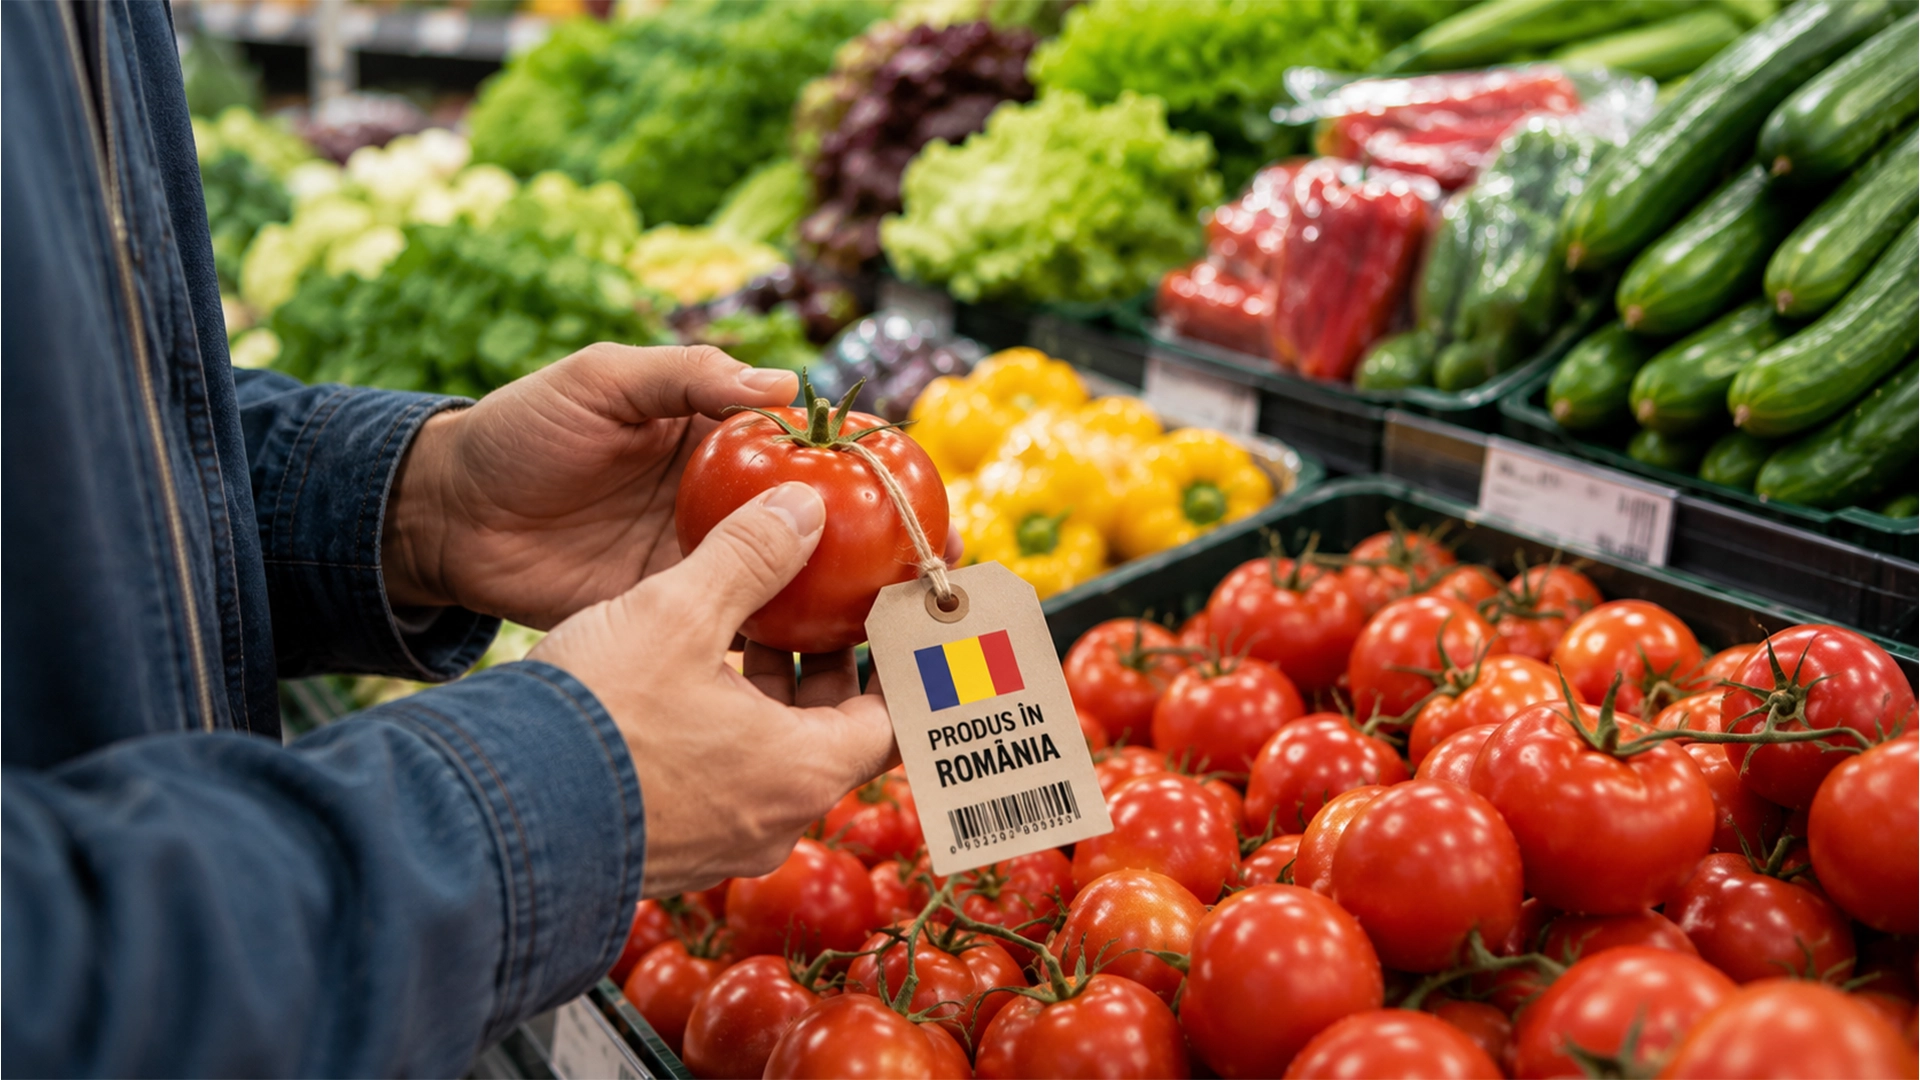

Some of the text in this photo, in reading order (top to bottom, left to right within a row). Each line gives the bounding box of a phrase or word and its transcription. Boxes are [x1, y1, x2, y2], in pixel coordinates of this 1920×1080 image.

[928, 702, 1044, 751] PRODUS ÎN
[935, 733, 1061, 788] ROMÂNIA
